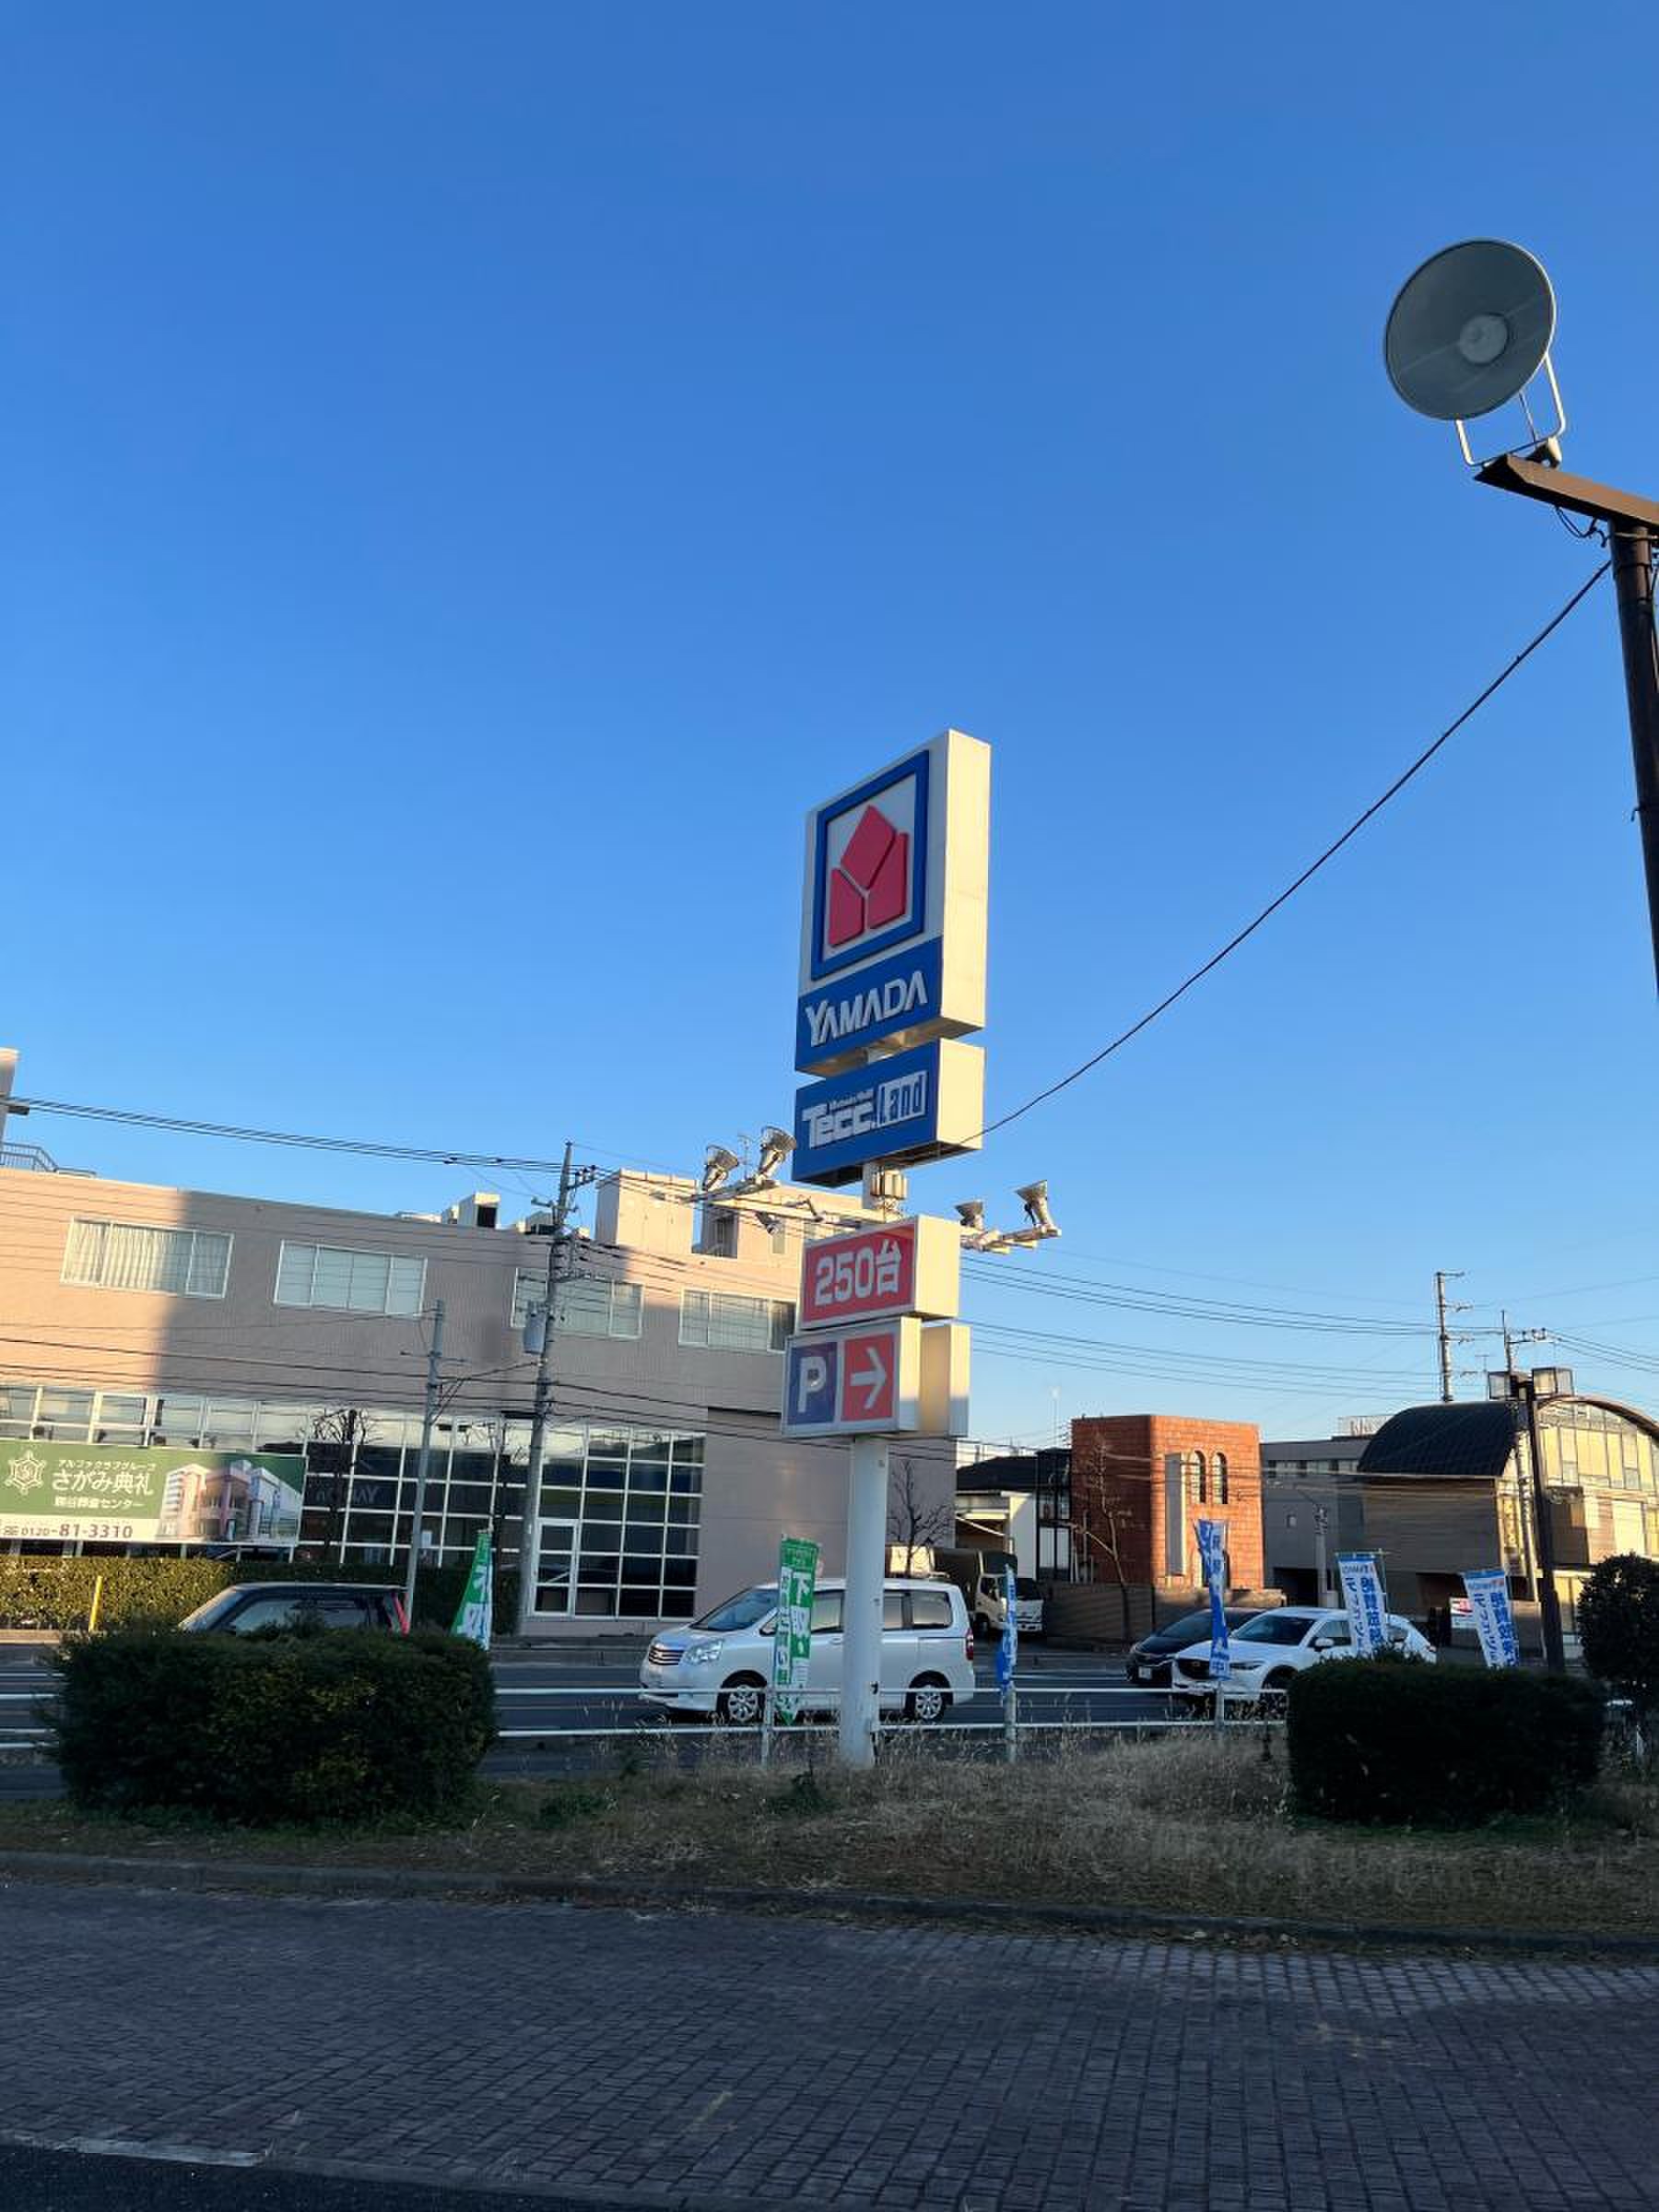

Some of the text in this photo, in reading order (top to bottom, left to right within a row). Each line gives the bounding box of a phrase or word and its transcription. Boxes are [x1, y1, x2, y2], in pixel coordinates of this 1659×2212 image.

[806, 971, 928, 1047] YAMADA
[814, 1239, 902, 1307] 250台
[797, 1356, 827, 1414] P
[52, 1469, 155, 1496] さがみ典礼
